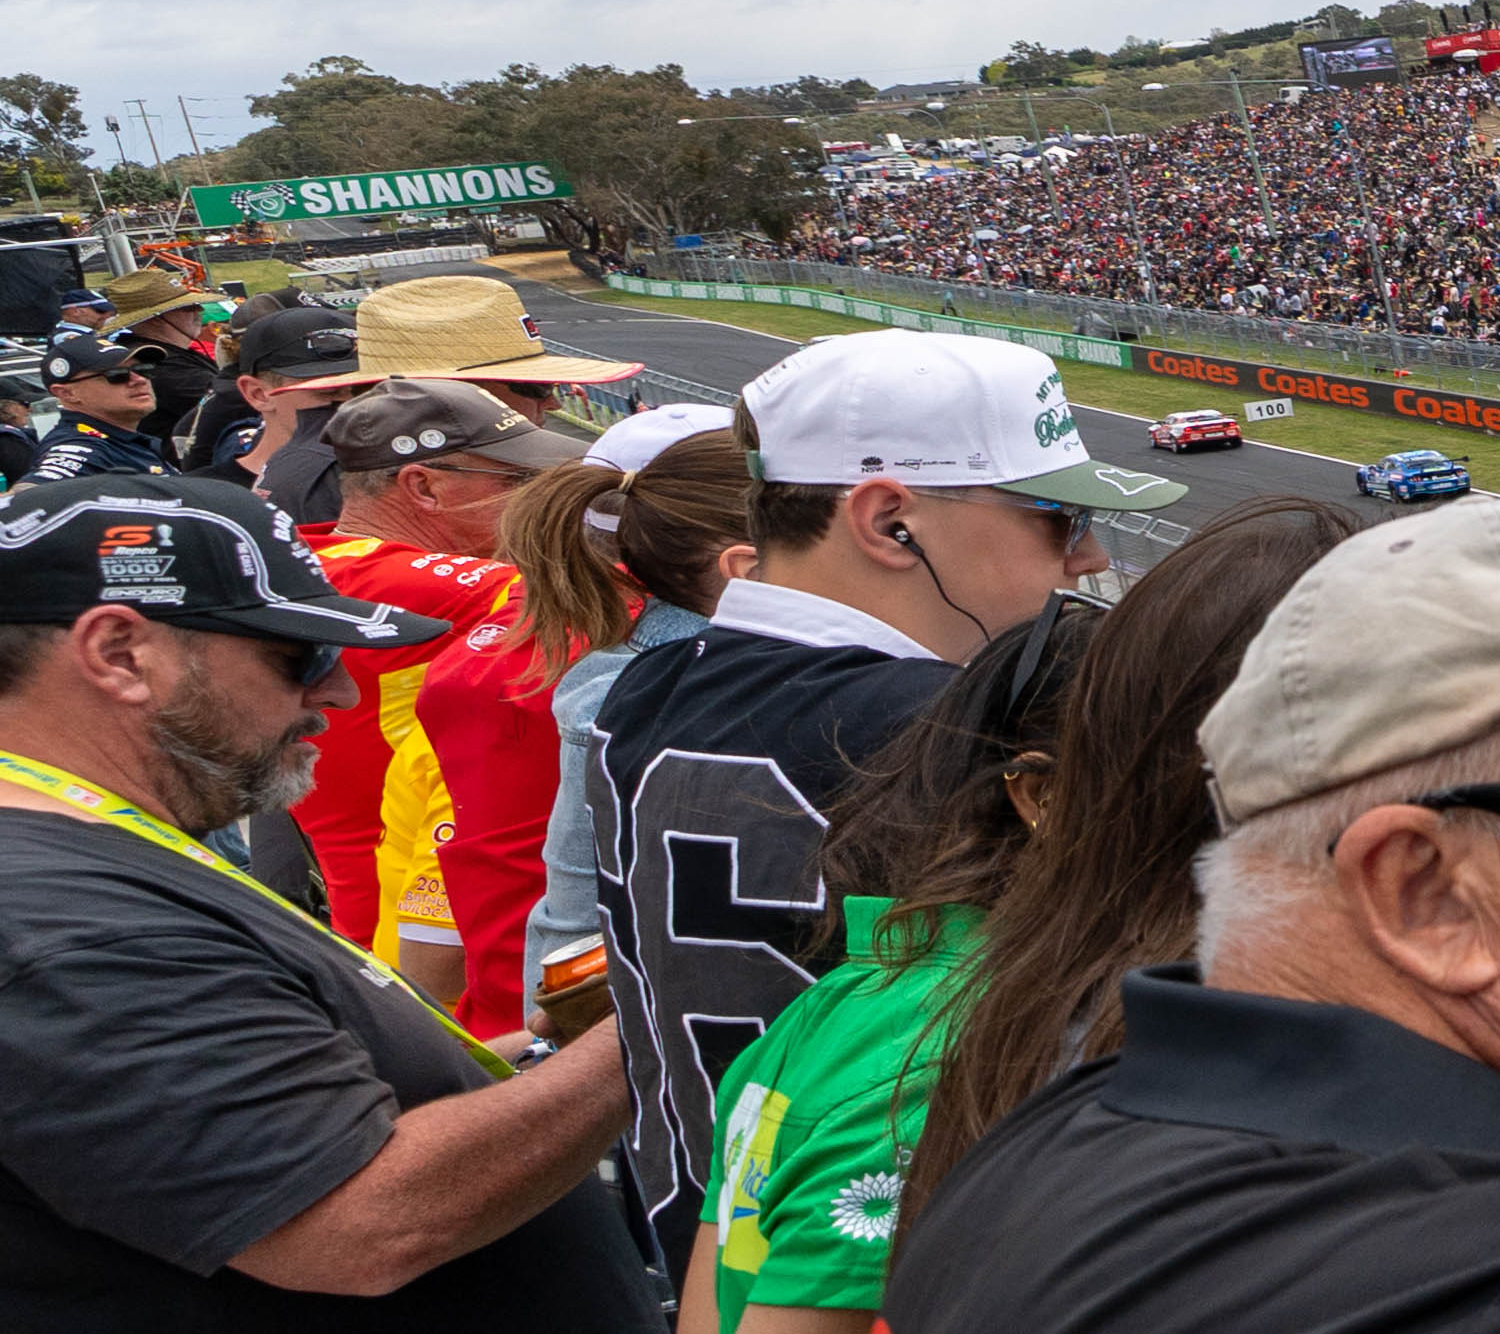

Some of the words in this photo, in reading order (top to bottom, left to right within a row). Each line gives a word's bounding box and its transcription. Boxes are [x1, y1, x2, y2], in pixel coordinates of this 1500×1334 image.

[299, 164, 557, 215] SHANNONS
[1147, 350, 1239, 386] Coates
[1257, 367, 1370, 408] Coates
[1256, 402, 1285, 417] 100
[101, 563, 160, 575] 1000
[397, 902, 451, 919] WILDCA
